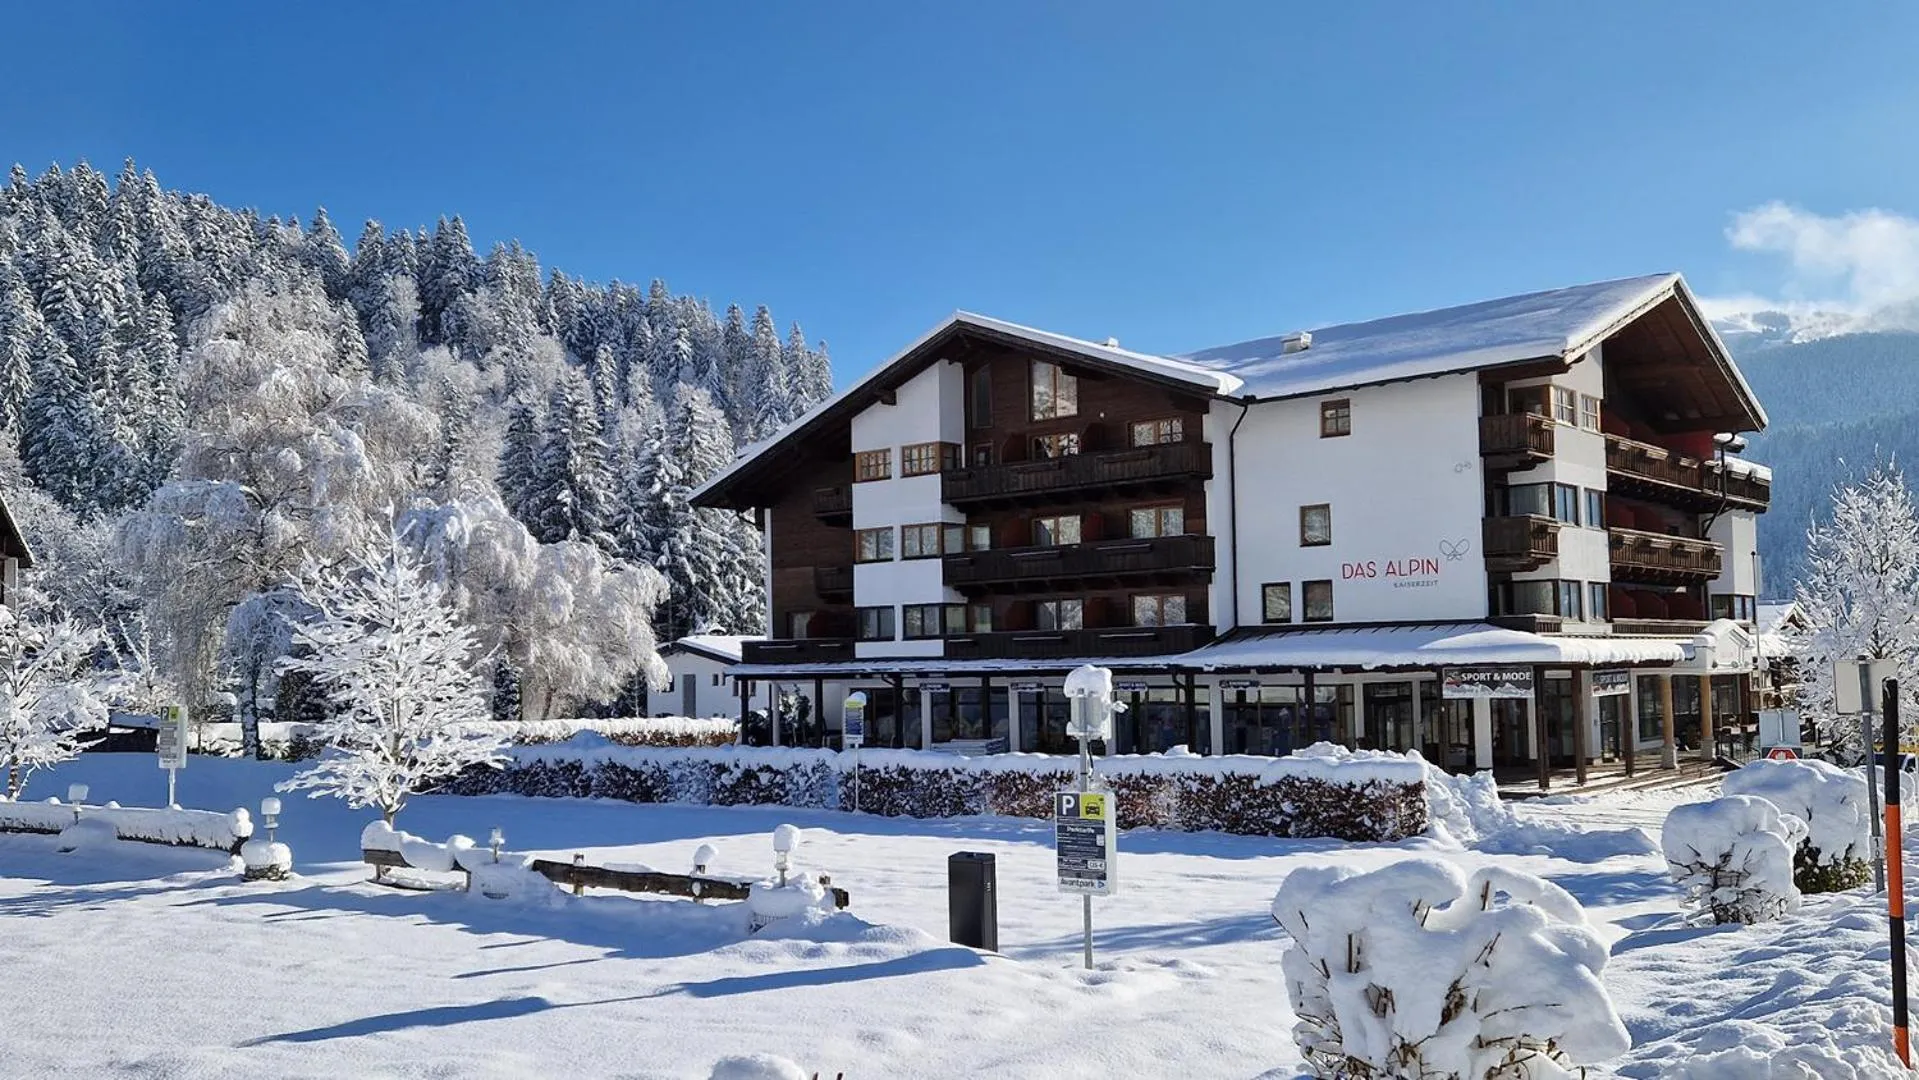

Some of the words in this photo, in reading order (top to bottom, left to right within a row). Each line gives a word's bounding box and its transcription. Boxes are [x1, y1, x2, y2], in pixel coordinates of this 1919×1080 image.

[1342, 561, 1377, 579] DAS
[1385, 557, 1439, 577] ALPIN
[1461, 672, 1491, 681] SPORT
[1493, 672, 1500, 680] &
[1502, 671, 1531, 680] MODE
[1062, 795, 1075, 815] P
